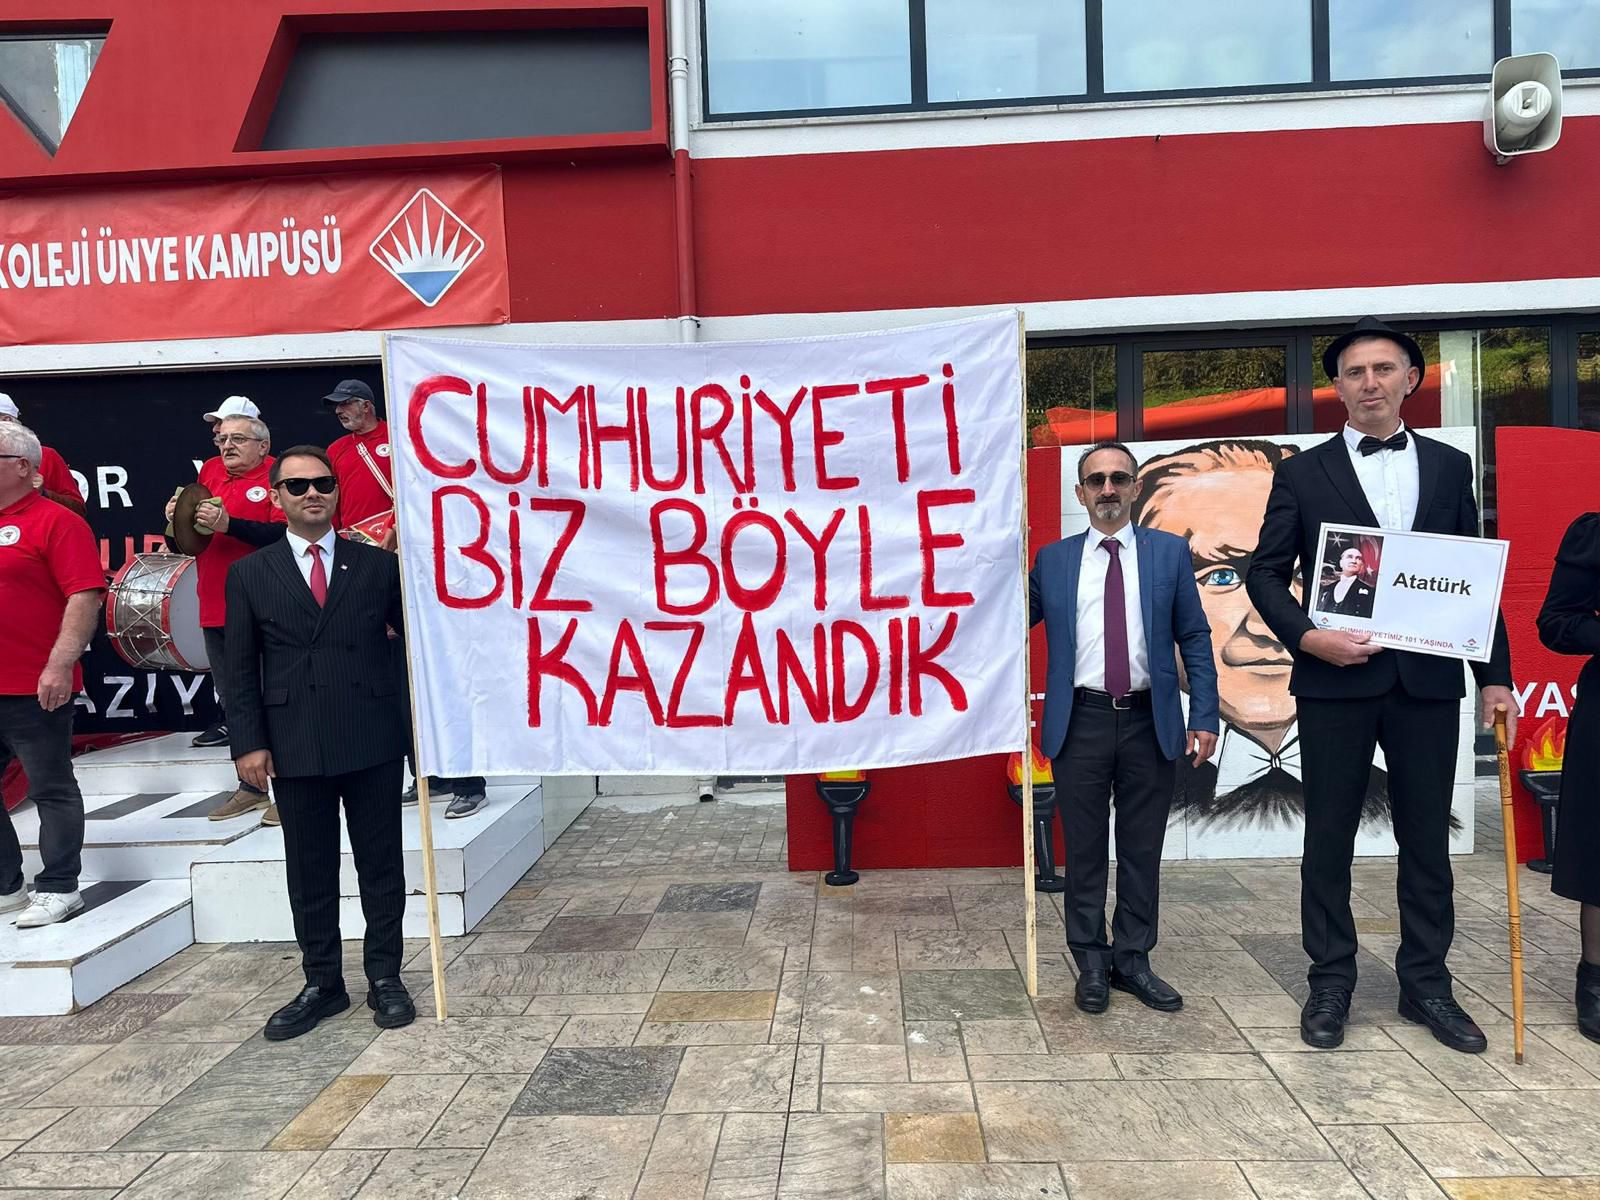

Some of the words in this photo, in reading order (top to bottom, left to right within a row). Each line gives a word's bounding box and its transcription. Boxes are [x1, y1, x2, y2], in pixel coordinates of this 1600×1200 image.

[96, 225, 179, 285] ÜNYE
[185, 214, 342, 281] KAMPÜSÜ
[408, 363, 961, 494] CUMHURİYETİ
[432, 485, 593, 612] BİZ
[649, 488, 976, 616] BÖYLE
[1392, 572, 1472, 596] Atatürk
[527, 611, 969, 728] KAZANDIK
[1405, 635, 1417, 643] 101
[1419, 638, 1454, 649] YAŞINDA
